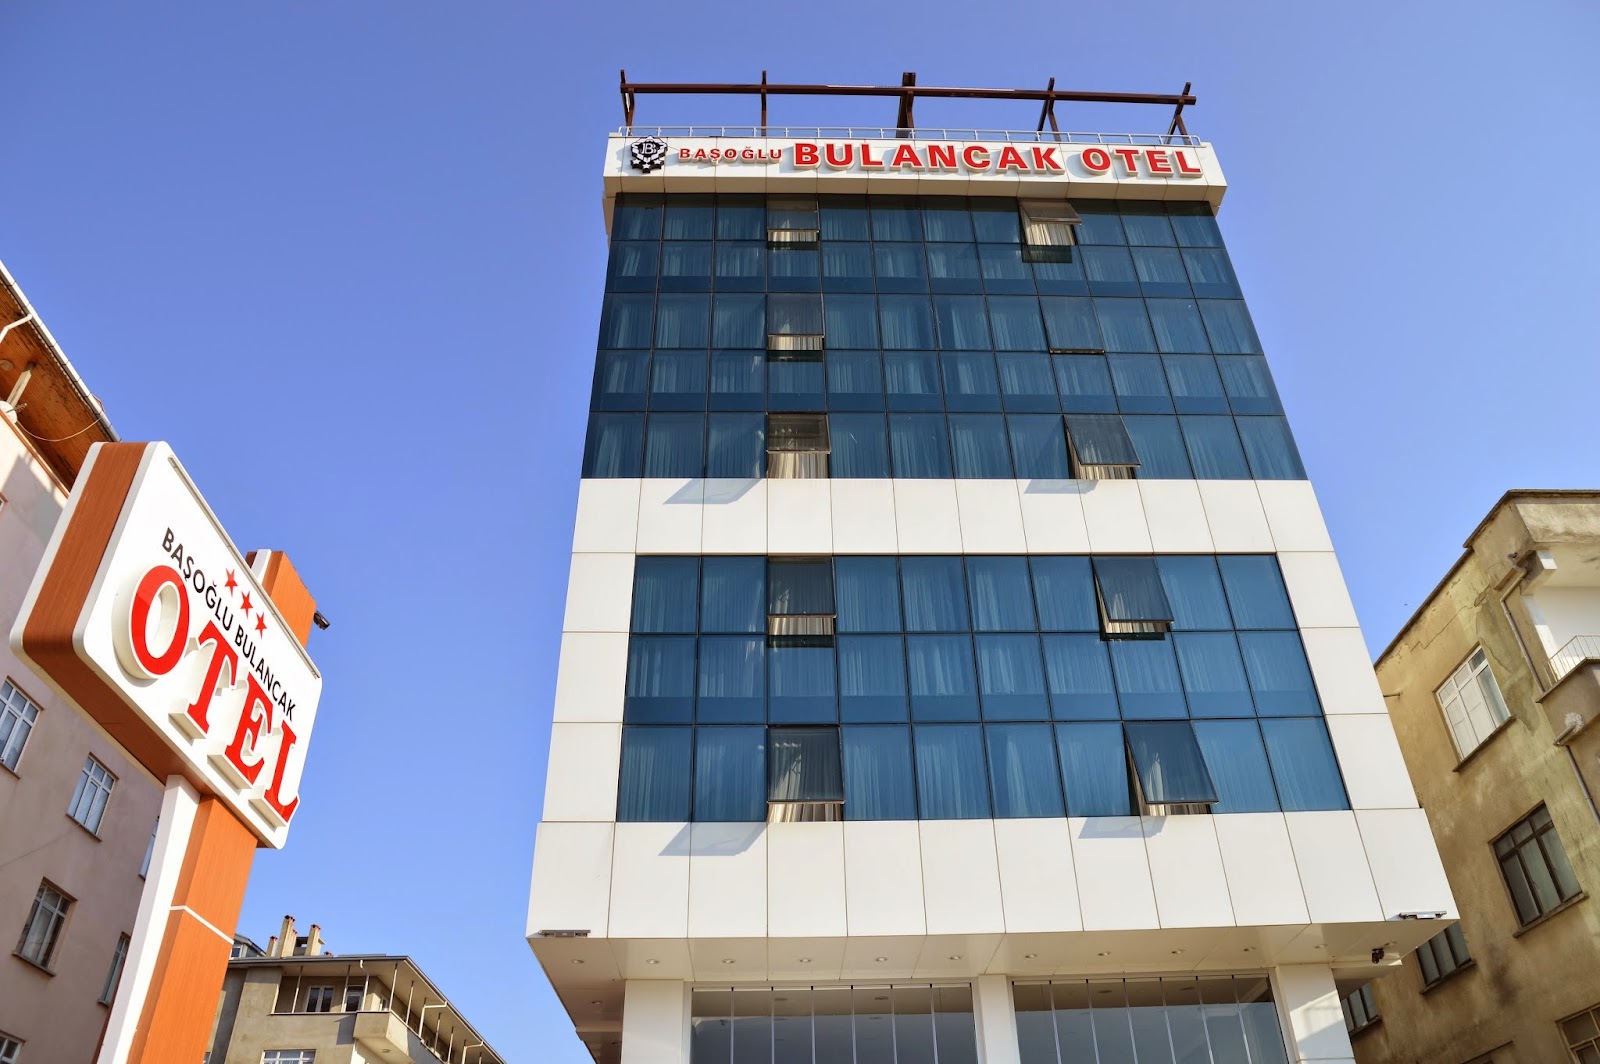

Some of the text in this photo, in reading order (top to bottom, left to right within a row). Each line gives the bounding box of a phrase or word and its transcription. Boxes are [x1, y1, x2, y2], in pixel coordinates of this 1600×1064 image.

[679, 142, 1202, 175] BAŞOĞLU BULANCAK OTEL
[131, 564, 299, 824] OTEL
[162, 526, 296, 722] BAŞOĞLU BULANCAK
